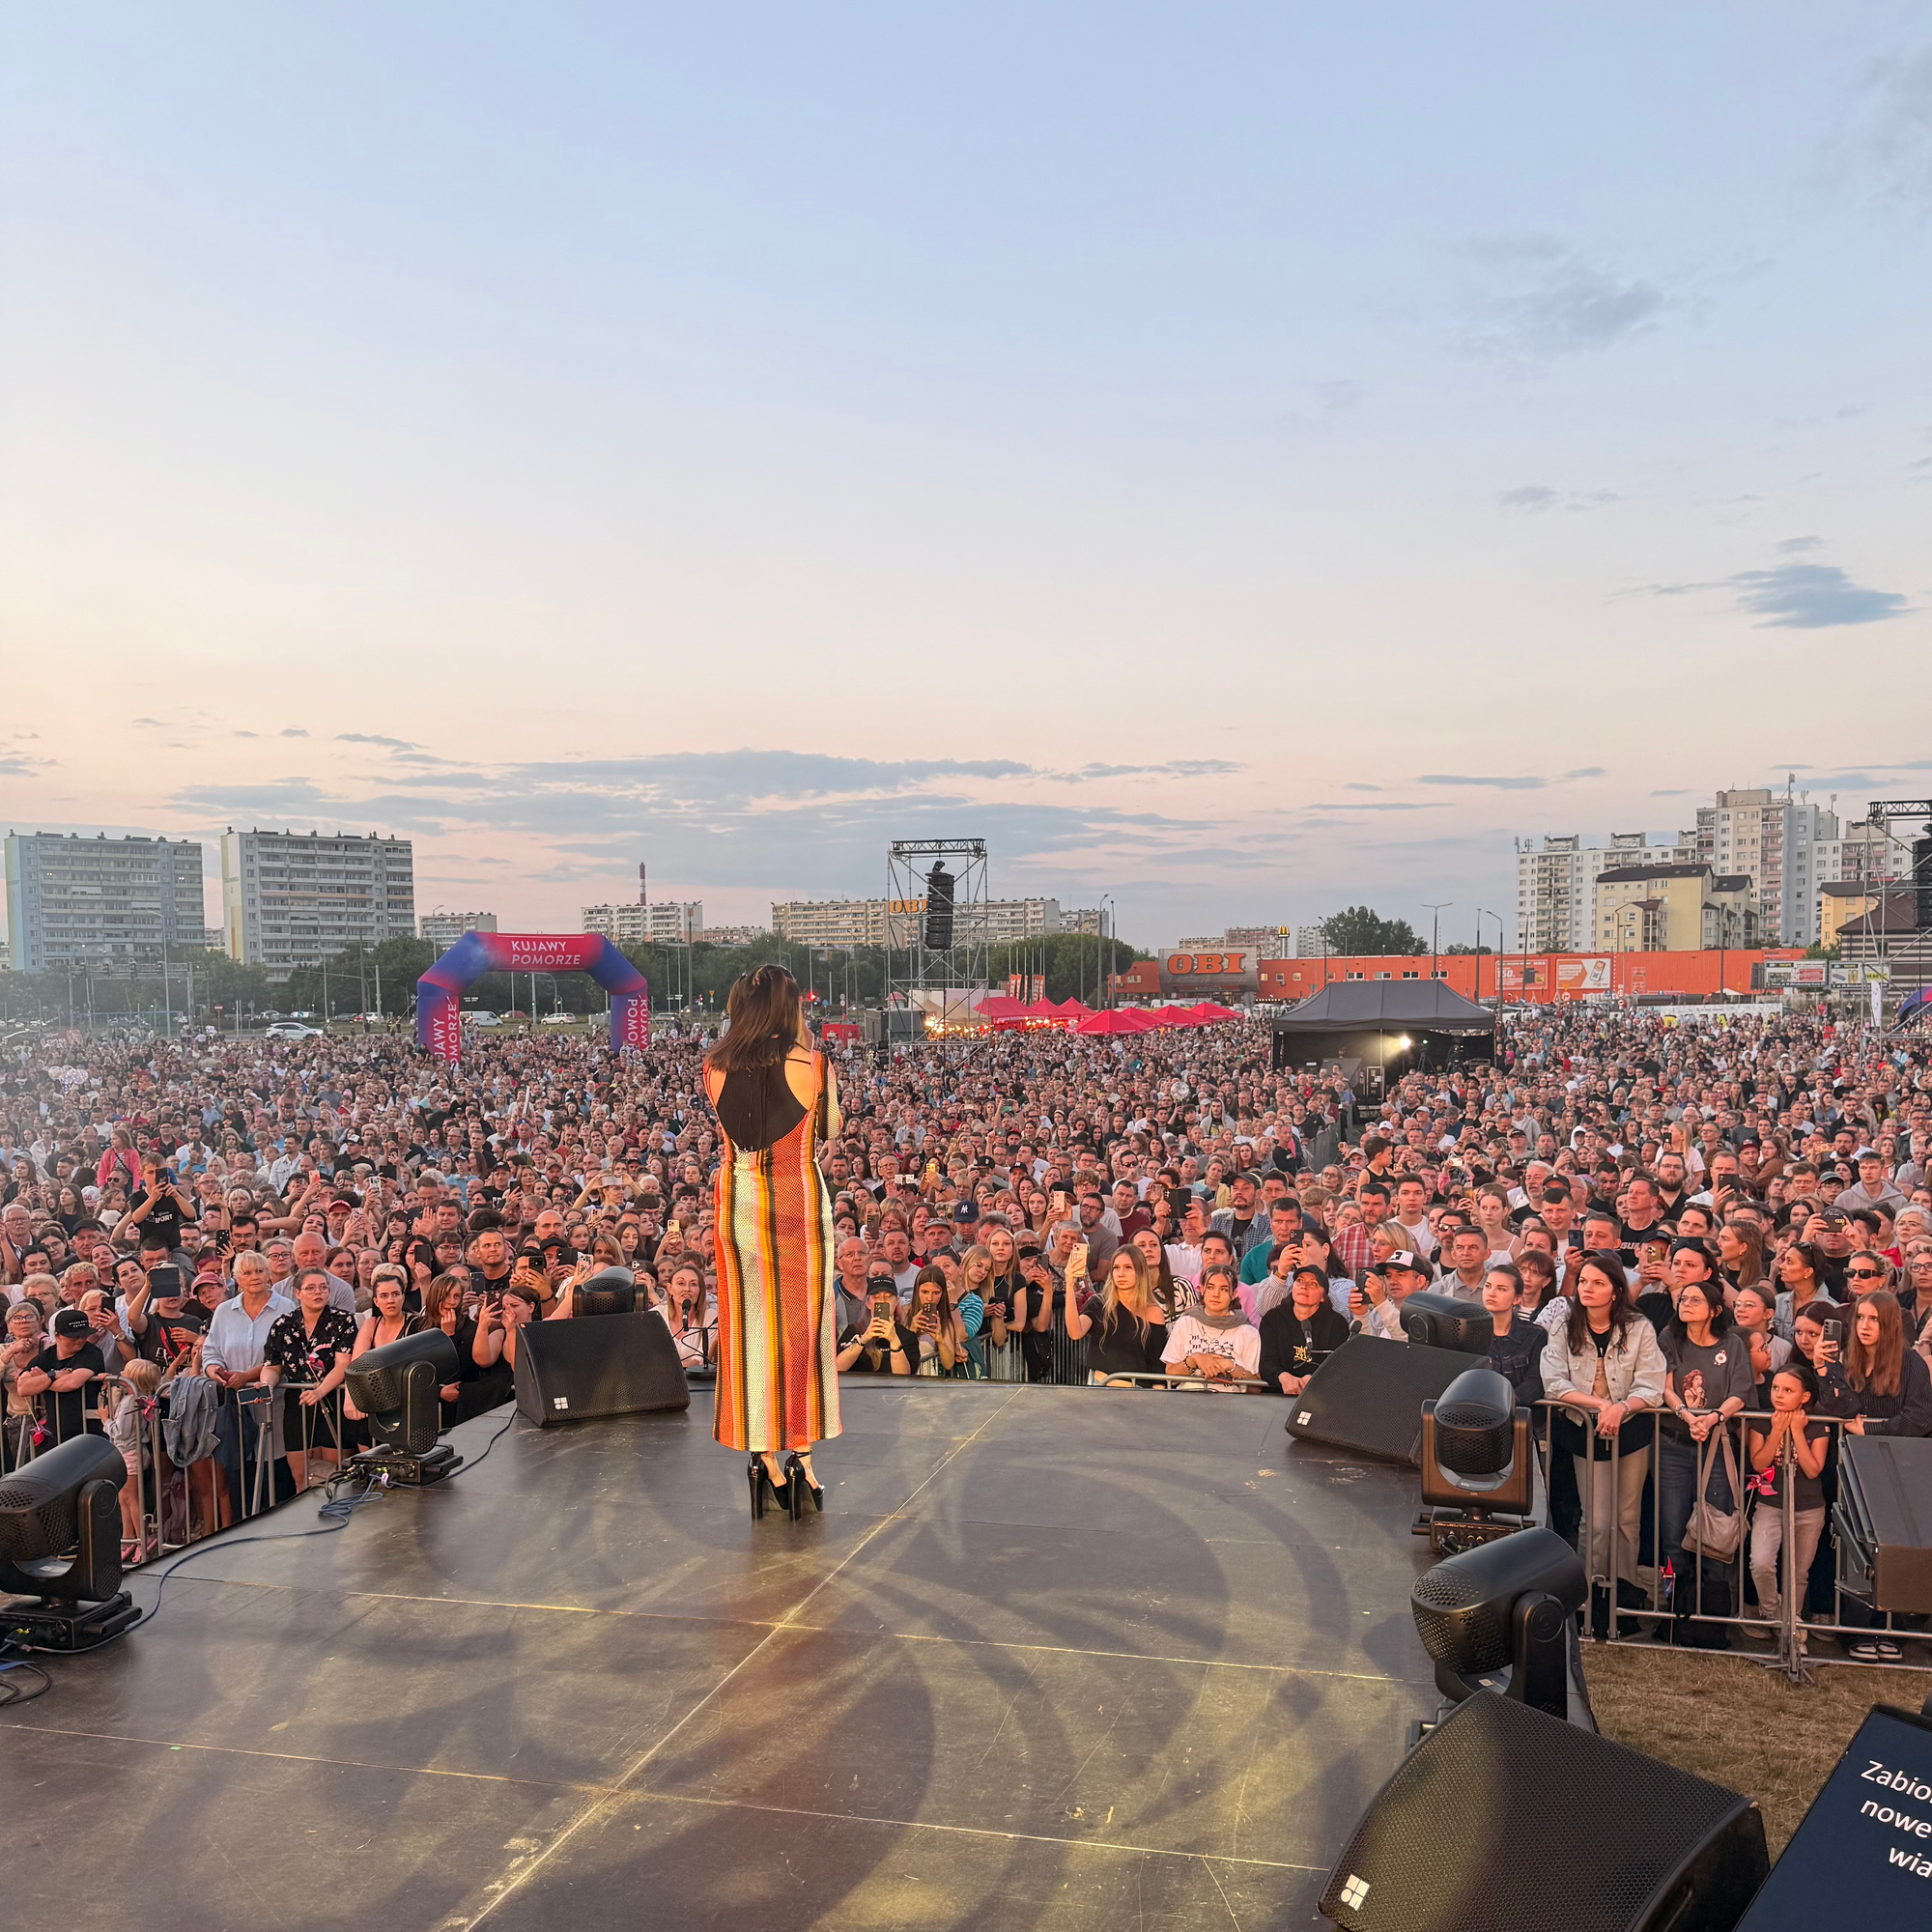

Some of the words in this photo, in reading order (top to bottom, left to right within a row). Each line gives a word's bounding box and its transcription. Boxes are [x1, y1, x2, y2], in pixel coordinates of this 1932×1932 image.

[889, 898, 929, 914] OBI
[511, 940, 567, 952] KUJAWY
[511, 953, 582, 965] POMORZE
[1167, 953, 1246, 975] OBI
[433, 1017, 446, 1062] JAWY
[639, 999, 648, 1049] KUJAW
[1861, 1760, 1932, 1804] Zabio
[1861, 1800, 1932, 1838] nowe
[1889, 1847, 1932, 1878] wia
